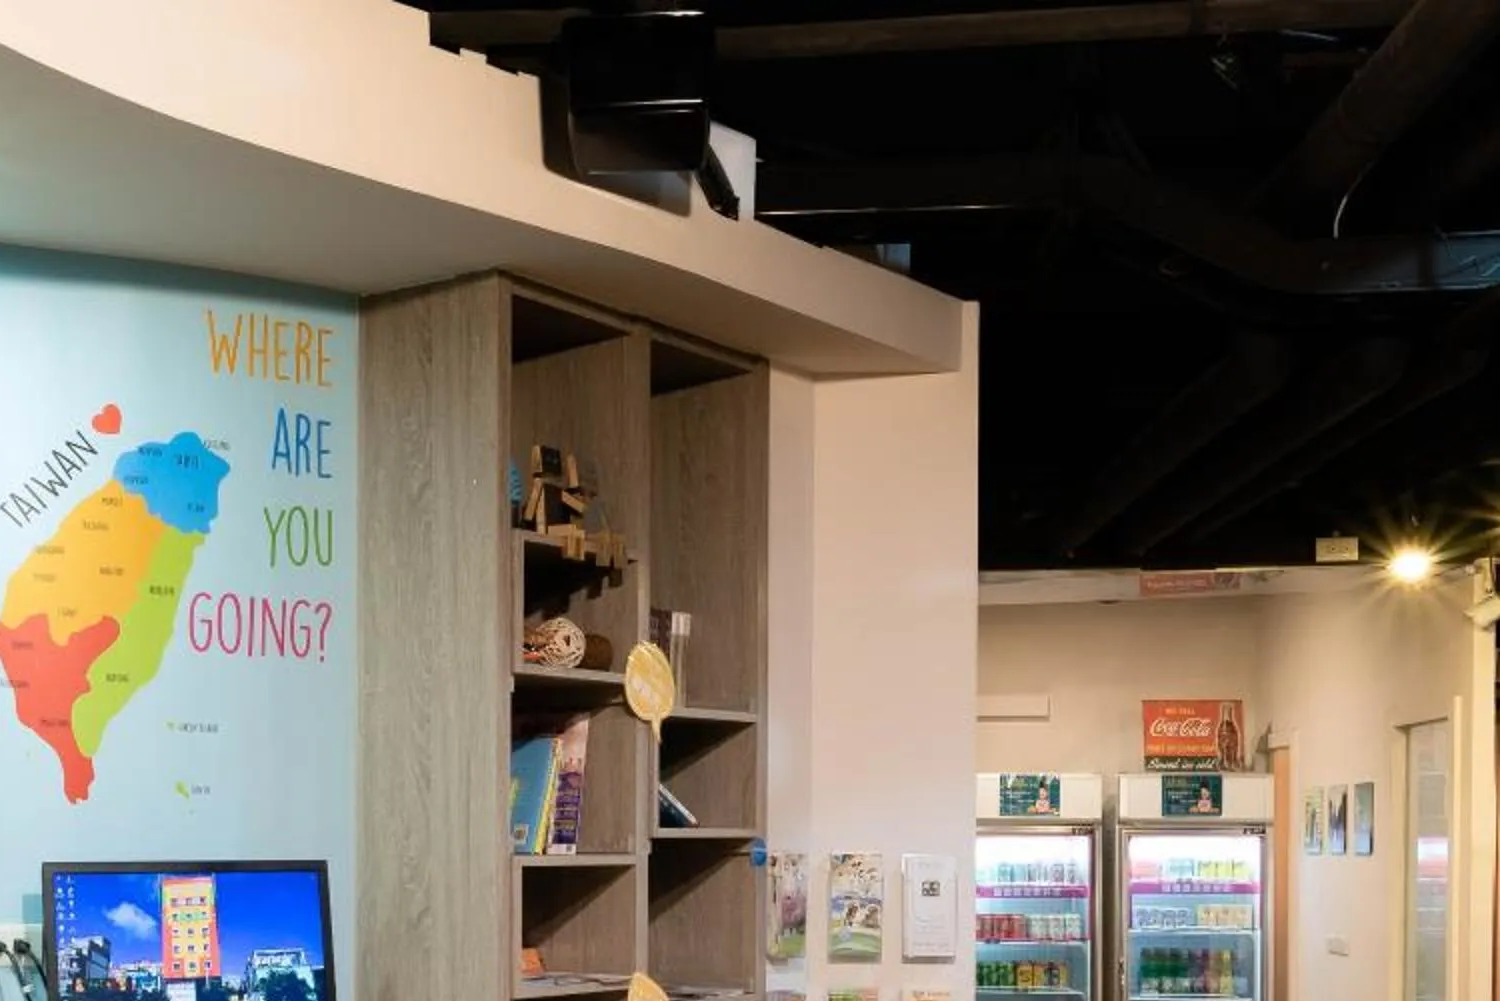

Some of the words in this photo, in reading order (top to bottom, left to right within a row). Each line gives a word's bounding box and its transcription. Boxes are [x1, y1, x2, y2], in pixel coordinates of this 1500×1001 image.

[206, 309, 333, 387] WHERE
[271, 407, 332, 479] ARE
[263, 505, 333, 569] YOU
[188, 591, 333, 663] GOING?
